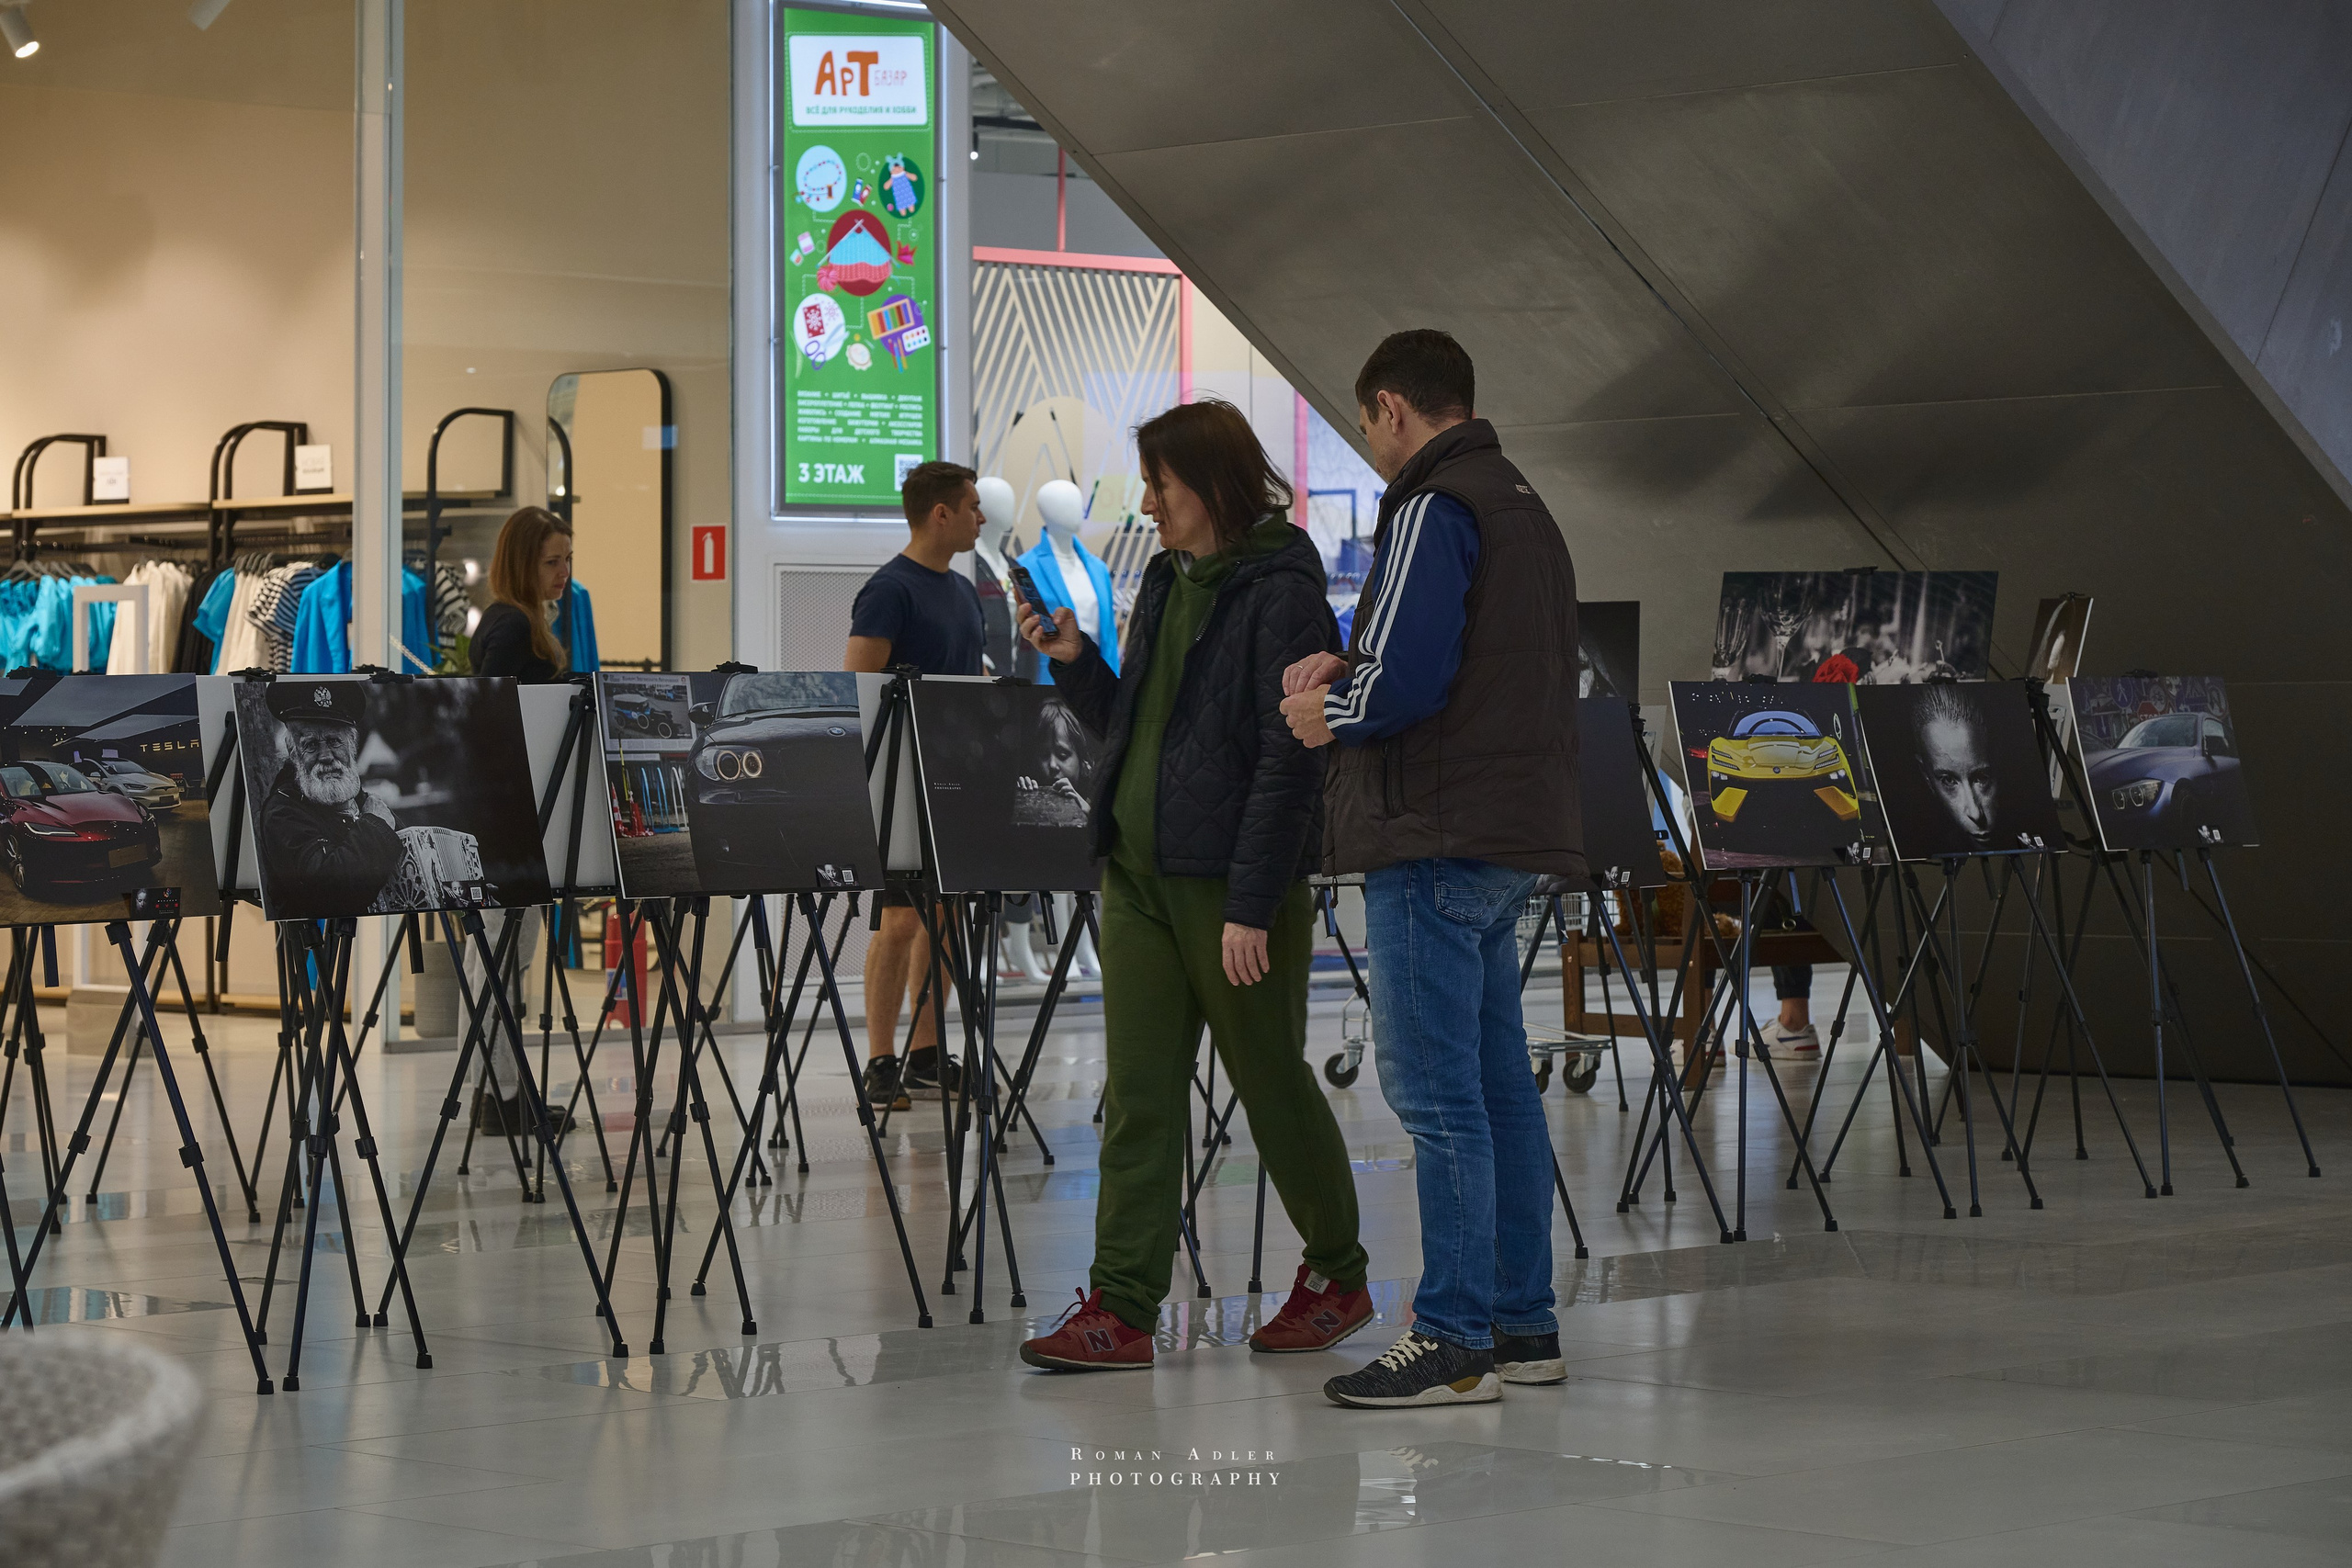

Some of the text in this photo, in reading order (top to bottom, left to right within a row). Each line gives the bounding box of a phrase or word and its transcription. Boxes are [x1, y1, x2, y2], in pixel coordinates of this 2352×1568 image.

[875, 70, 908, 85] БАЗАР
[806, 105, 820, 114] ВСЁ
[821, 107, 837, 115] ДЛЯ
[839, 107, 883, 115] РУКОДЕЛИЯ
[798, 462, 865, 484] 3 ЭТАЖ
[140, 739, 199, 752] TESLA
